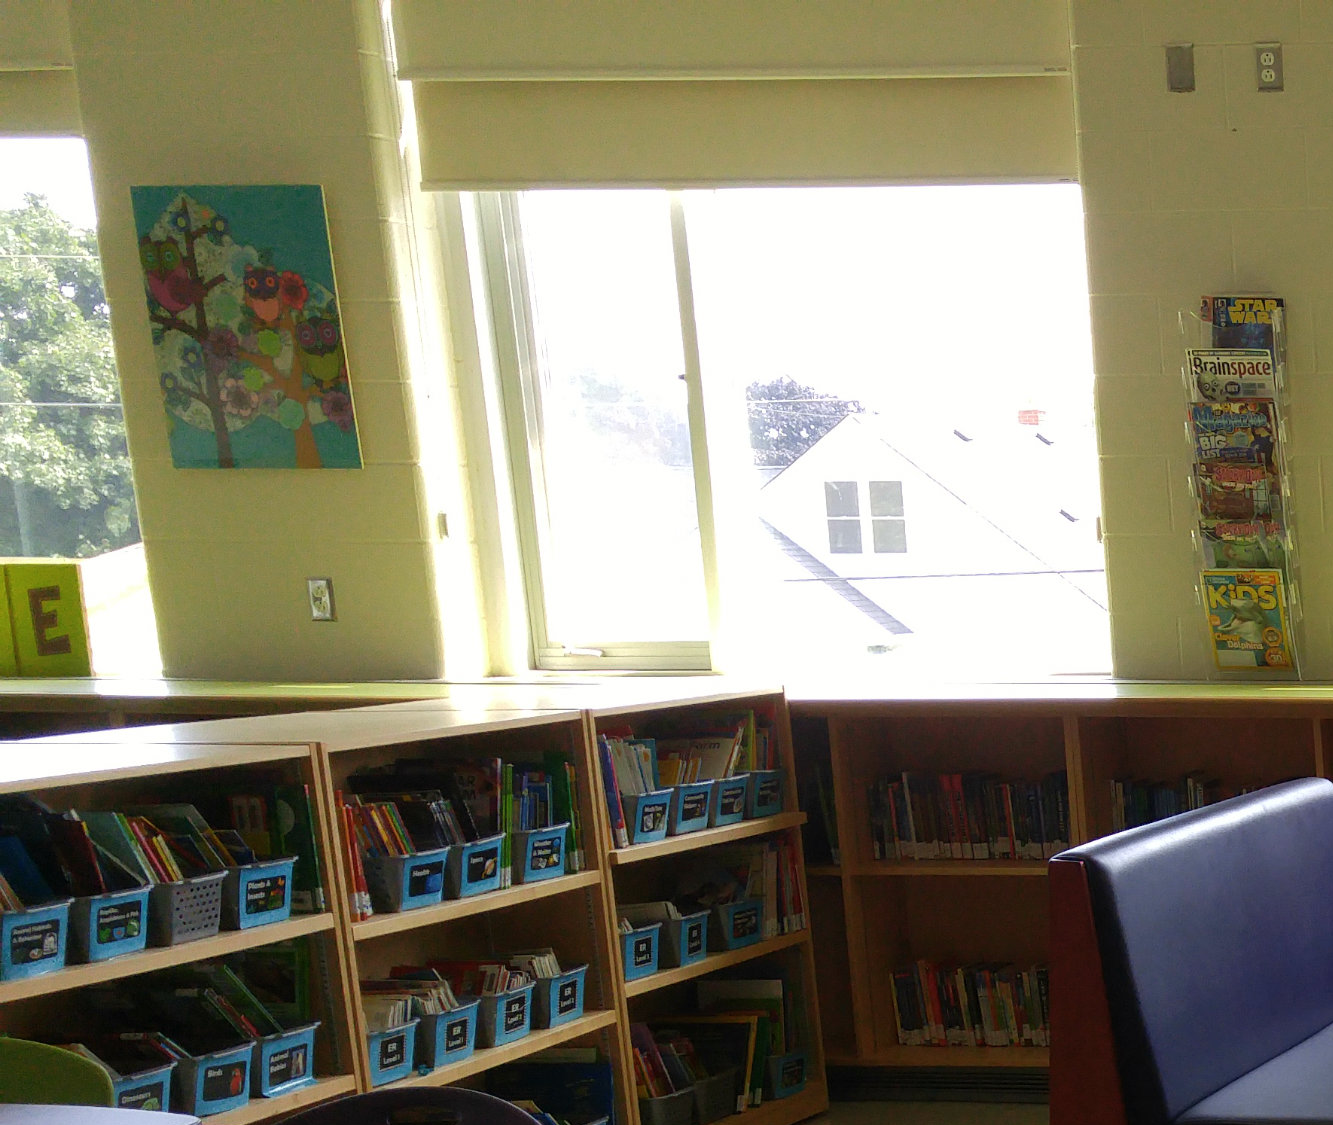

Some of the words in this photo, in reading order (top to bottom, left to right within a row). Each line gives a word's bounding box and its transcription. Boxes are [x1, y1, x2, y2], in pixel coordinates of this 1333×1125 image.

[1228, 299, 1278, 312] STAR
[1193, 357, 1271, 378] Brainspace
[1199, 434, 1228, 450] BIG
[27, 585, 72, 657] E
[453, 1026, 462, 1036] ER
[387, 1042, 397, 1053] ER
[383, 1055, 397, 1065] Level
